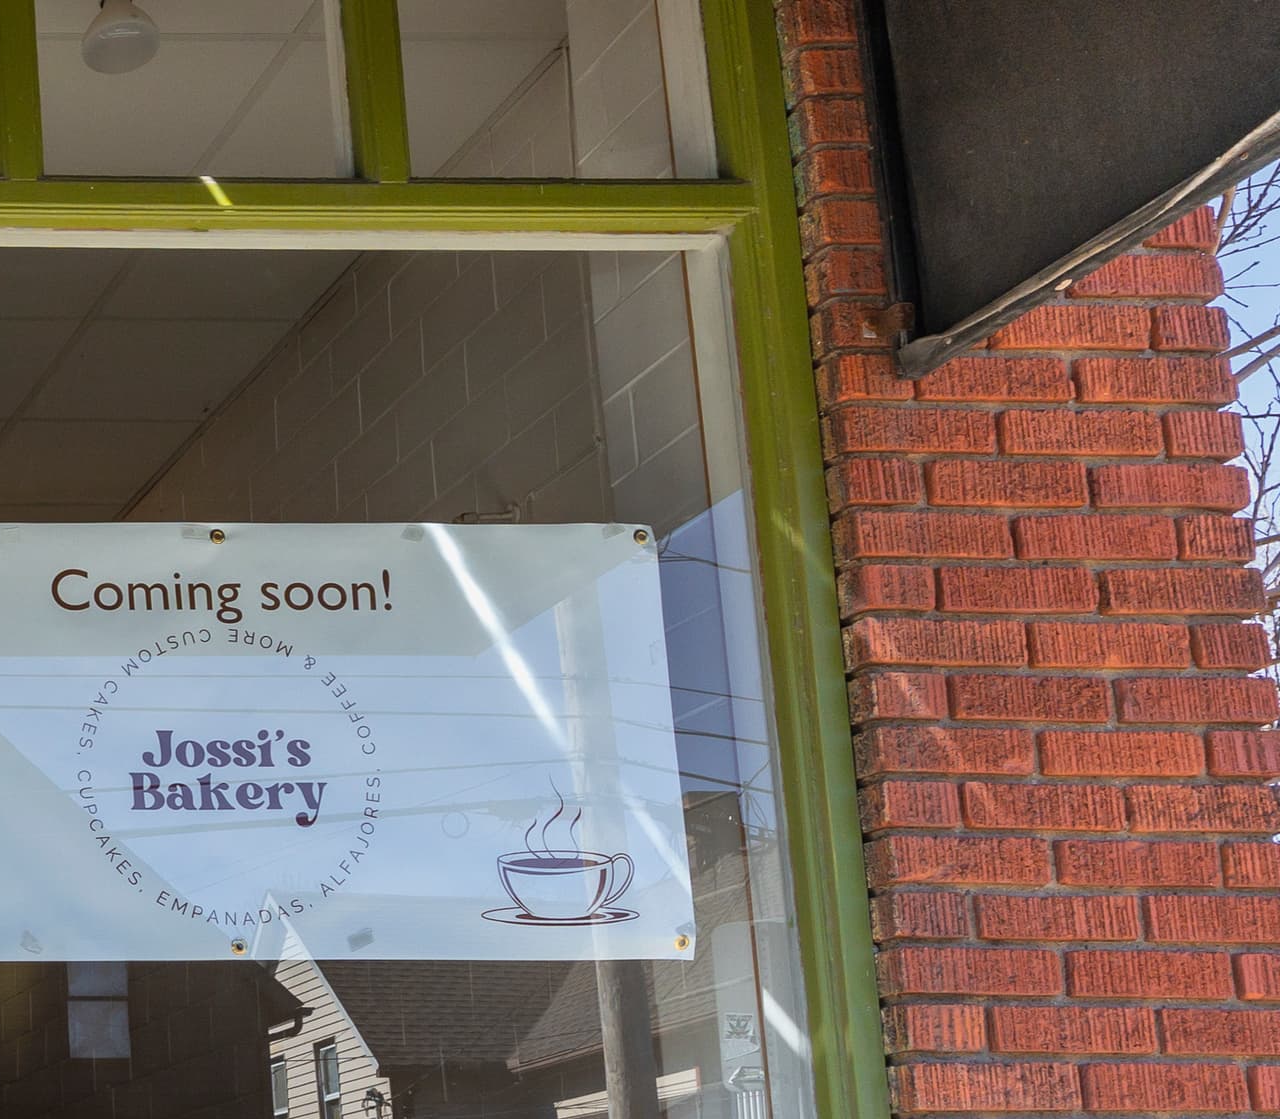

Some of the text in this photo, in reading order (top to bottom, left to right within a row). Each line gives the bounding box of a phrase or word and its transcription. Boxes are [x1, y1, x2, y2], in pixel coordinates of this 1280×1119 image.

[51, 568, 393, 624] Coming soon!
[121, 628, 211, 676] CUSTOM
[228, 628, 293, 657] MORE
[303, 654, 317, 670] &
[76, 680, 118, 755] CAKES,
[321, 671, 376, 755] COFFEE
[142, 729, 311, 768] Jossi's
[128, 772, 327, 828] Bakery
[77, 769, 143, 893] CUPCAKES,
[155, 890, 313, 926] EMPANADAS,
